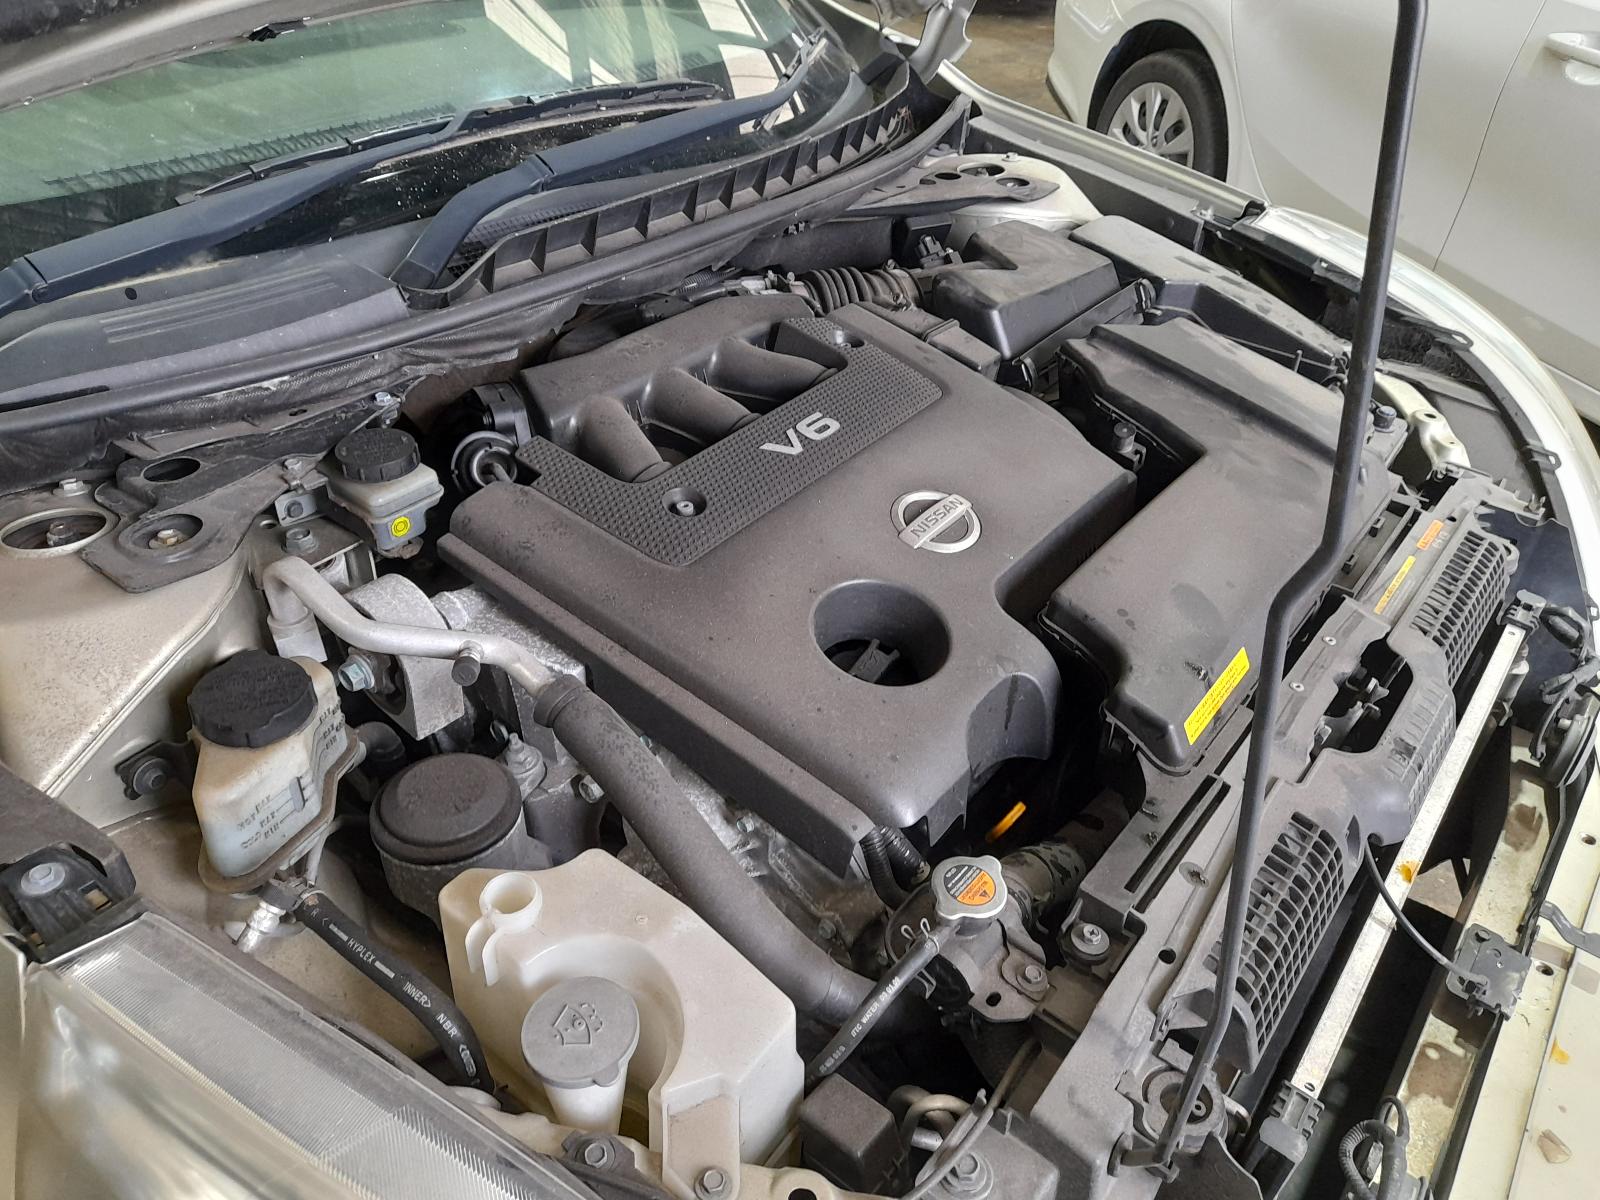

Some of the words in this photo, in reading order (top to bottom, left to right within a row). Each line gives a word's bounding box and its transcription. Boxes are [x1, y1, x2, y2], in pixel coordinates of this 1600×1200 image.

[758, 411, 841, 455] V6
[910, 498, 964, 538] NISSAN
[347, 938, 376, 965] HYPLEX
[436, 1012, 458, 1038] NBR
[861, 1001, 880, 1024] WATER
